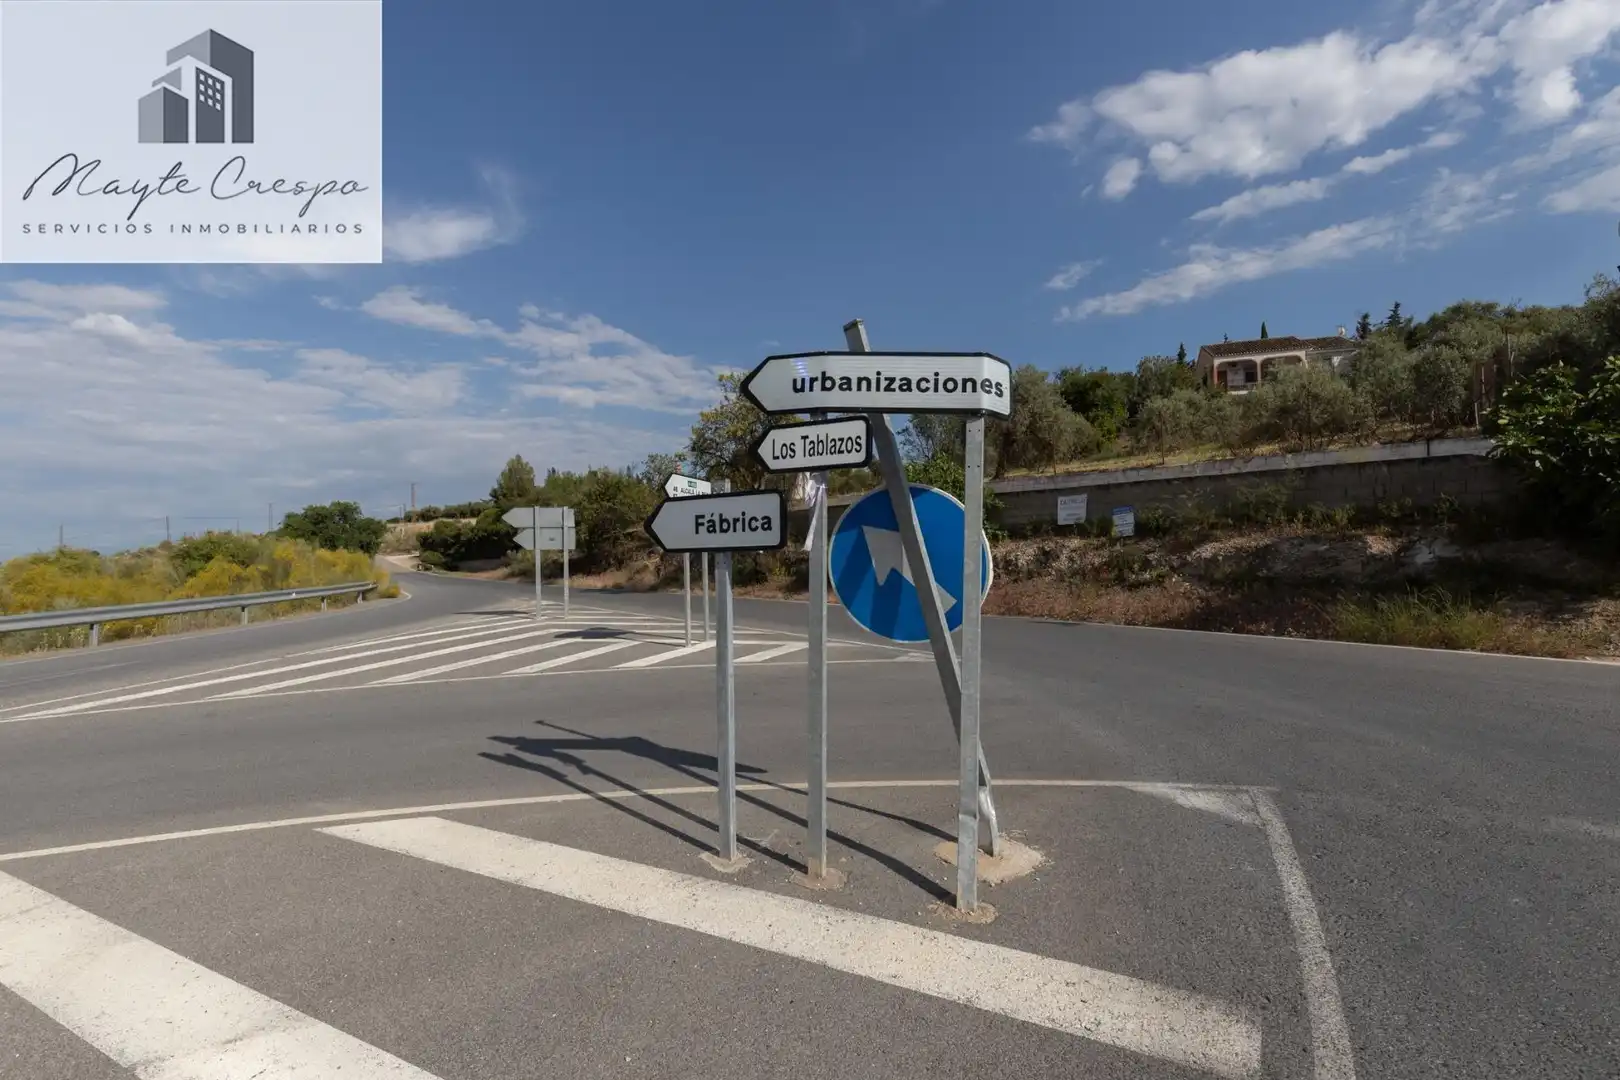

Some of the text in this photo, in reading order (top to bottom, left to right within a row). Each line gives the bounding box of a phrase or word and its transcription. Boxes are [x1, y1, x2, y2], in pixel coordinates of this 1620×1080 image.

[791, 370, 1005, 399] urbanizaciones
[772, 432, 863, 461] Los Tablazos
[694, 511, 773, 536] Fábrica
